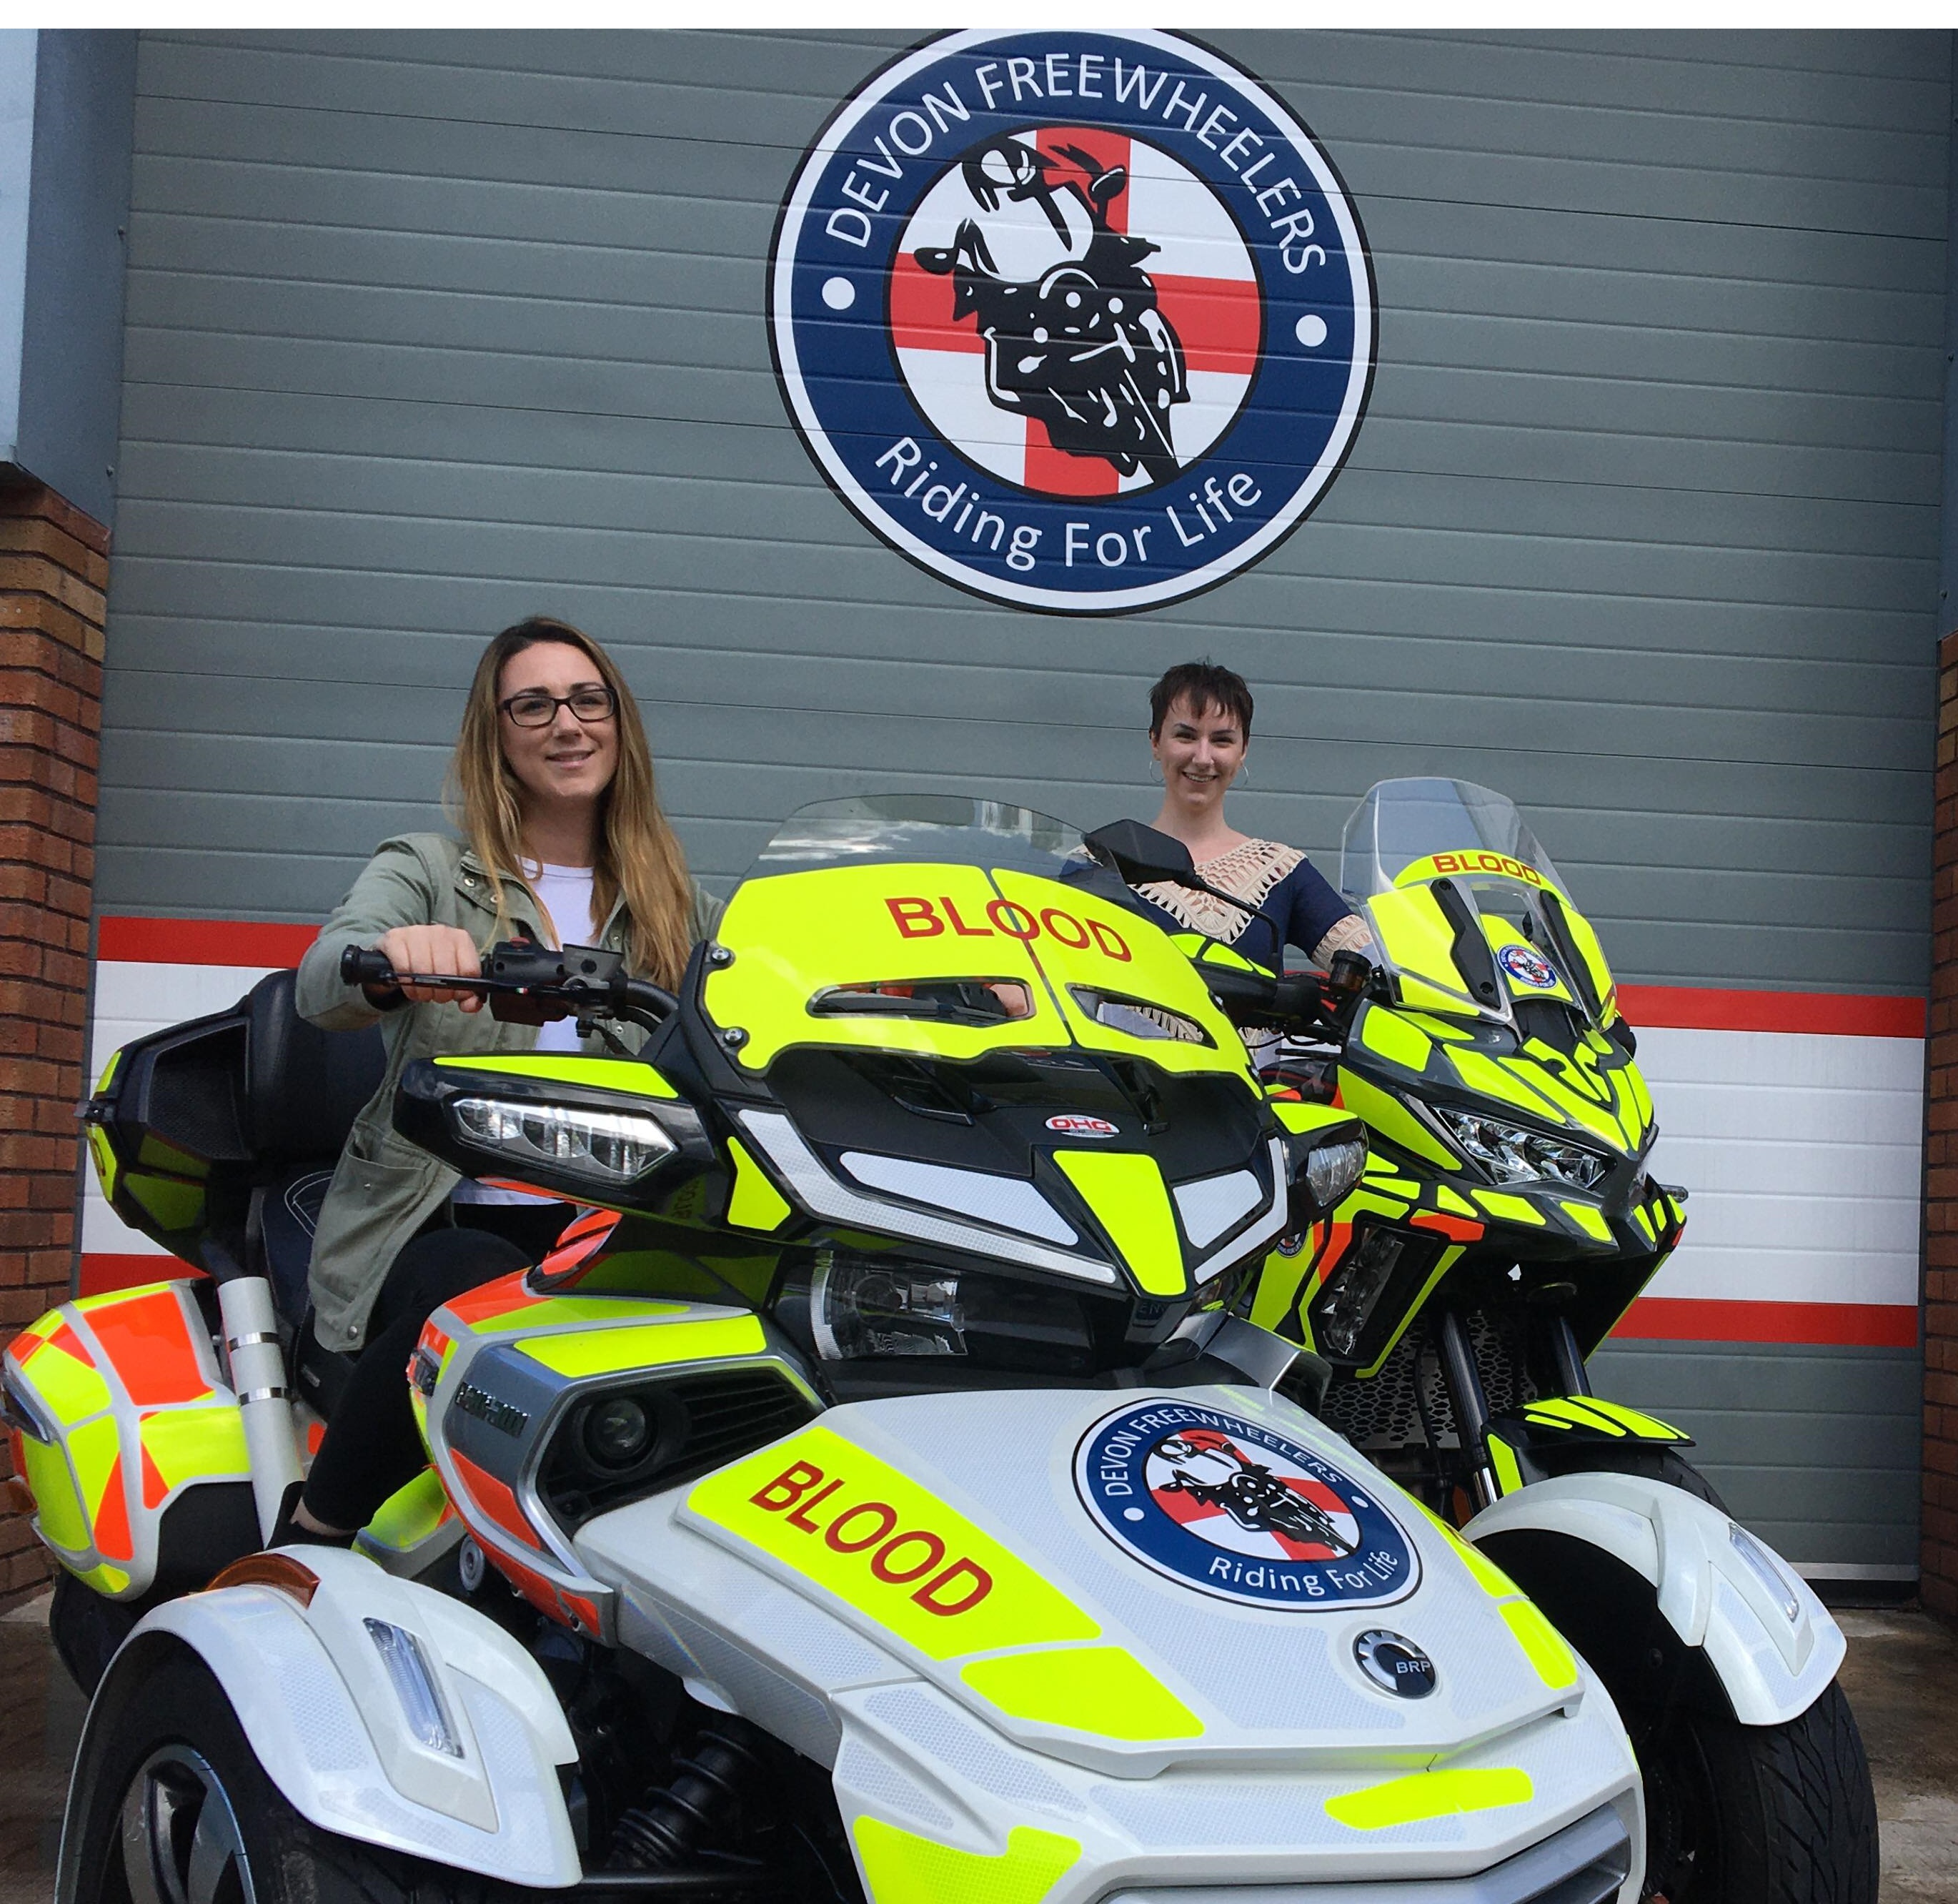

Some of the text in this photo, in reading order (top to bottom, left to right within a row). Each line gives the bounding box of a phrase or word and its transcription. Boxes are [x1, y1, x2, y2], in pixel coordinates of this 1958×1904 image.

[825, 53, 1326, 274] DEVON FREEWHEELERS
[875, 437, 1263, 572] Riding For Life
[1431, 854, 1541, 886] BLOOD
[883, 896, 1133, 963] BLOOD
[1100, 1408, 1343, 1496] DEVON FREEWHEELERS
[747, 1459, 993, 1617] BLOOD
[1208, 1551, 1398, 1596] Riding For Life
[1396, 1661, 1431, 1675] BRP
